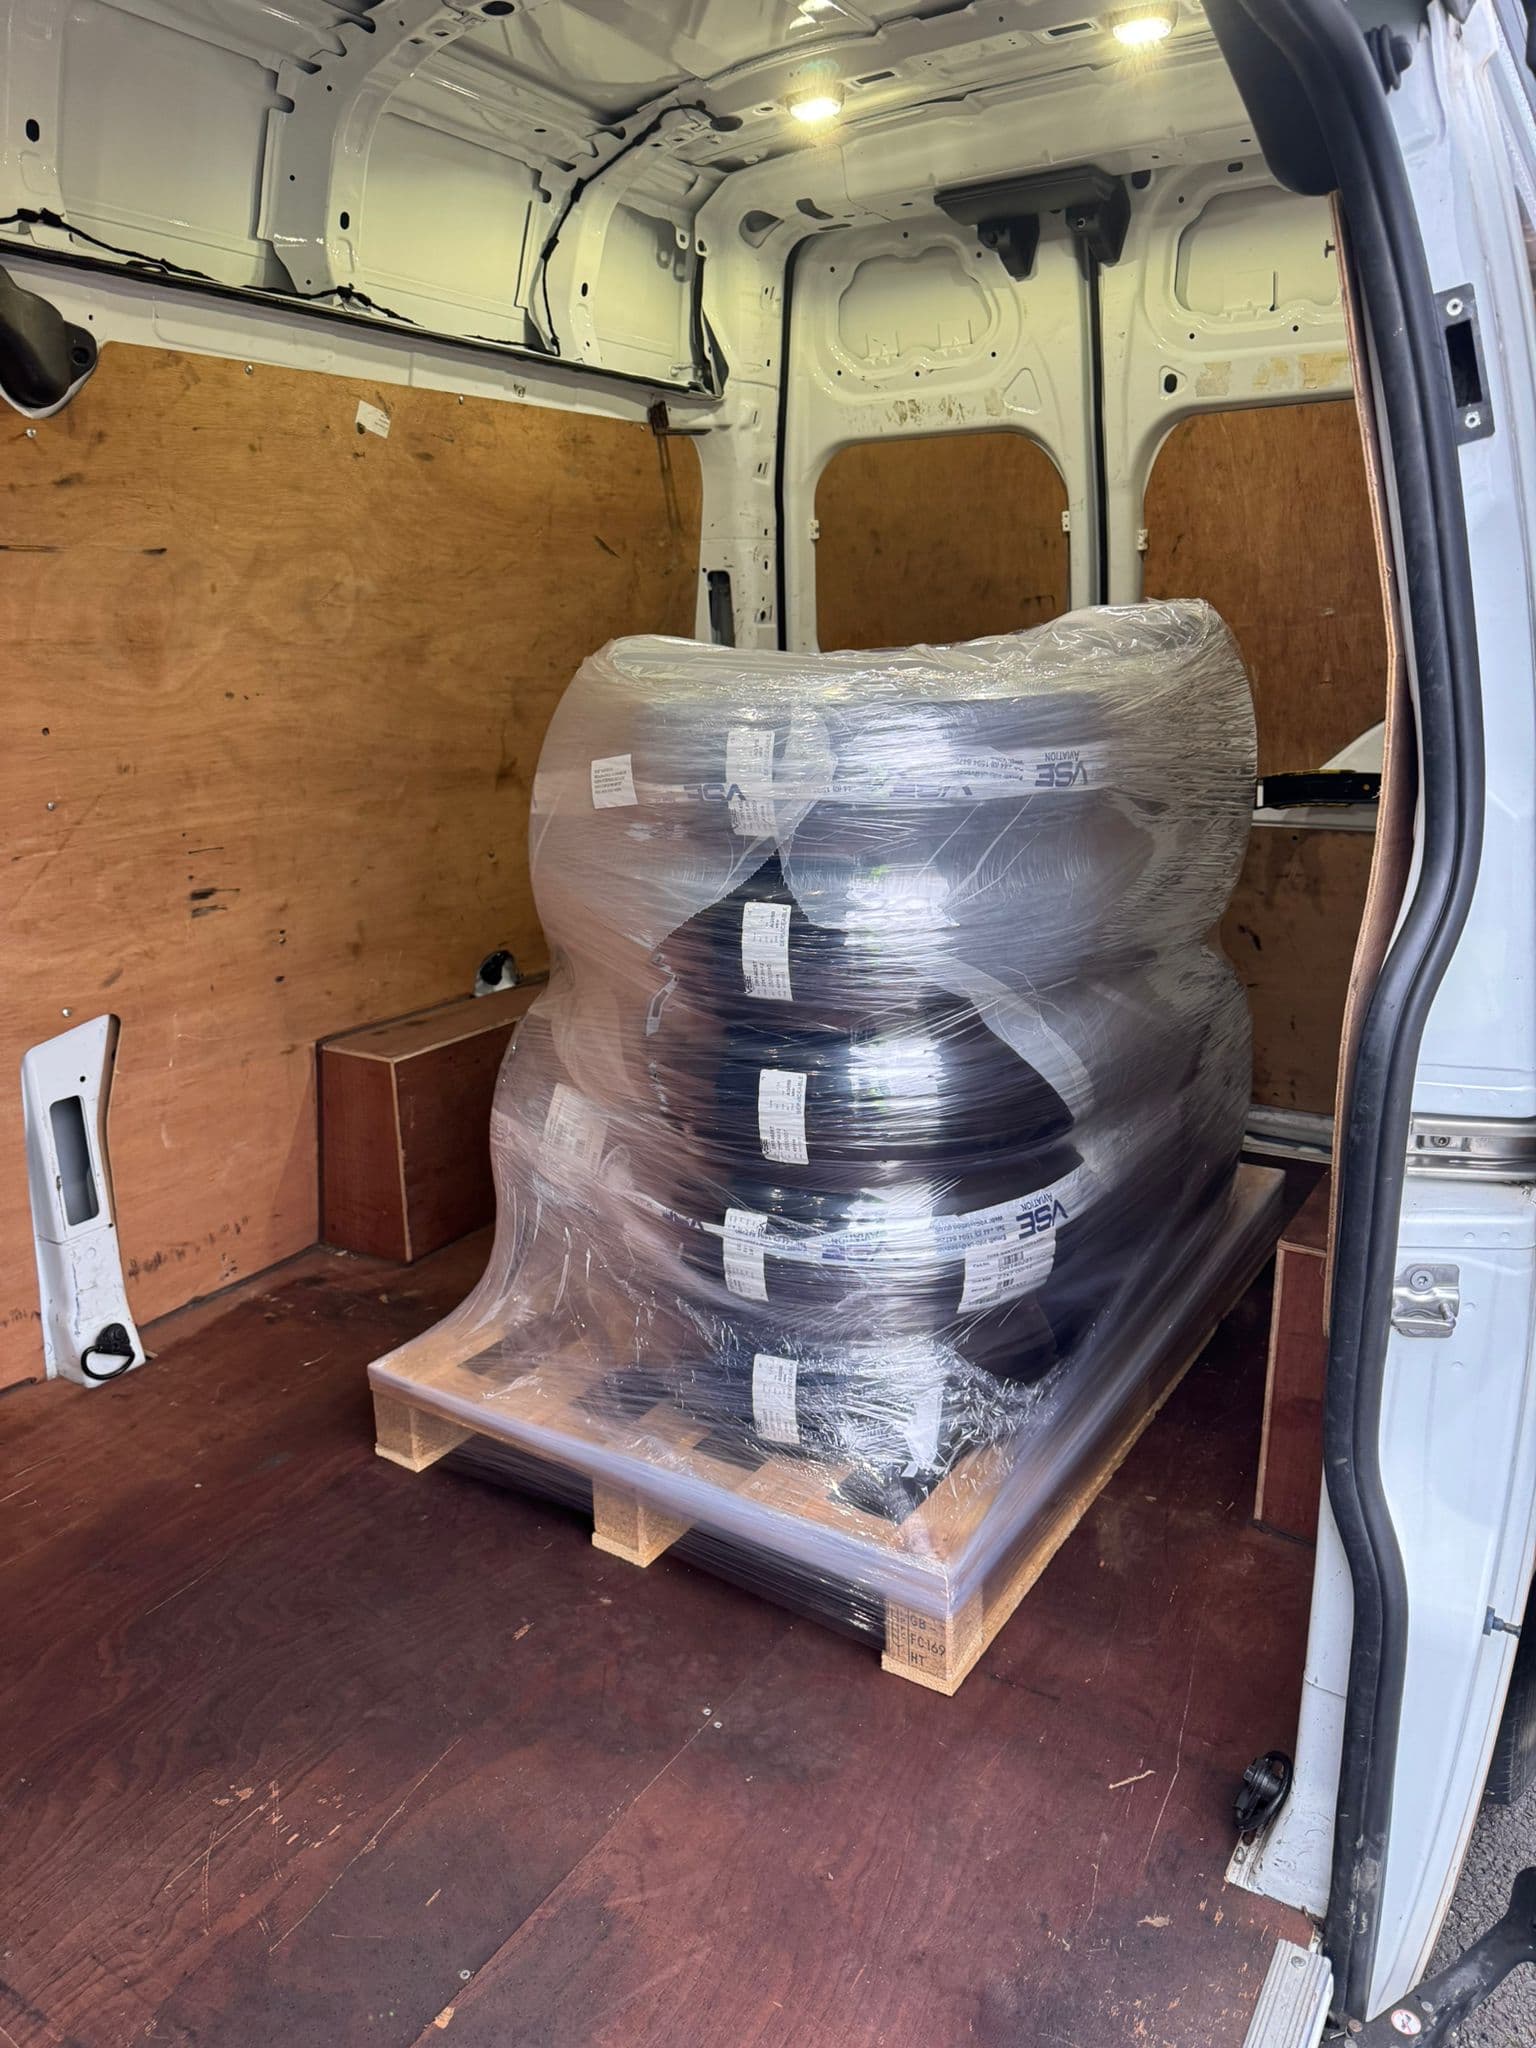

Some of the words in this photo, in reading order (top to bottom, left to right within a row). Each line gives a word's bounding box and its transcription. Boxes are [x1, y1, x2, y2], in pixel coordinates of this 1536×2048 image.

[1045, 750, 1080, 762] AVIATION
[1034, 761, 1088, 787] VSE
[1021, 1192, 1054, 1212] AVIATION
[1016, 1199, 1069, 1240] VSE
[910, 1651, 928, 1666] HT
